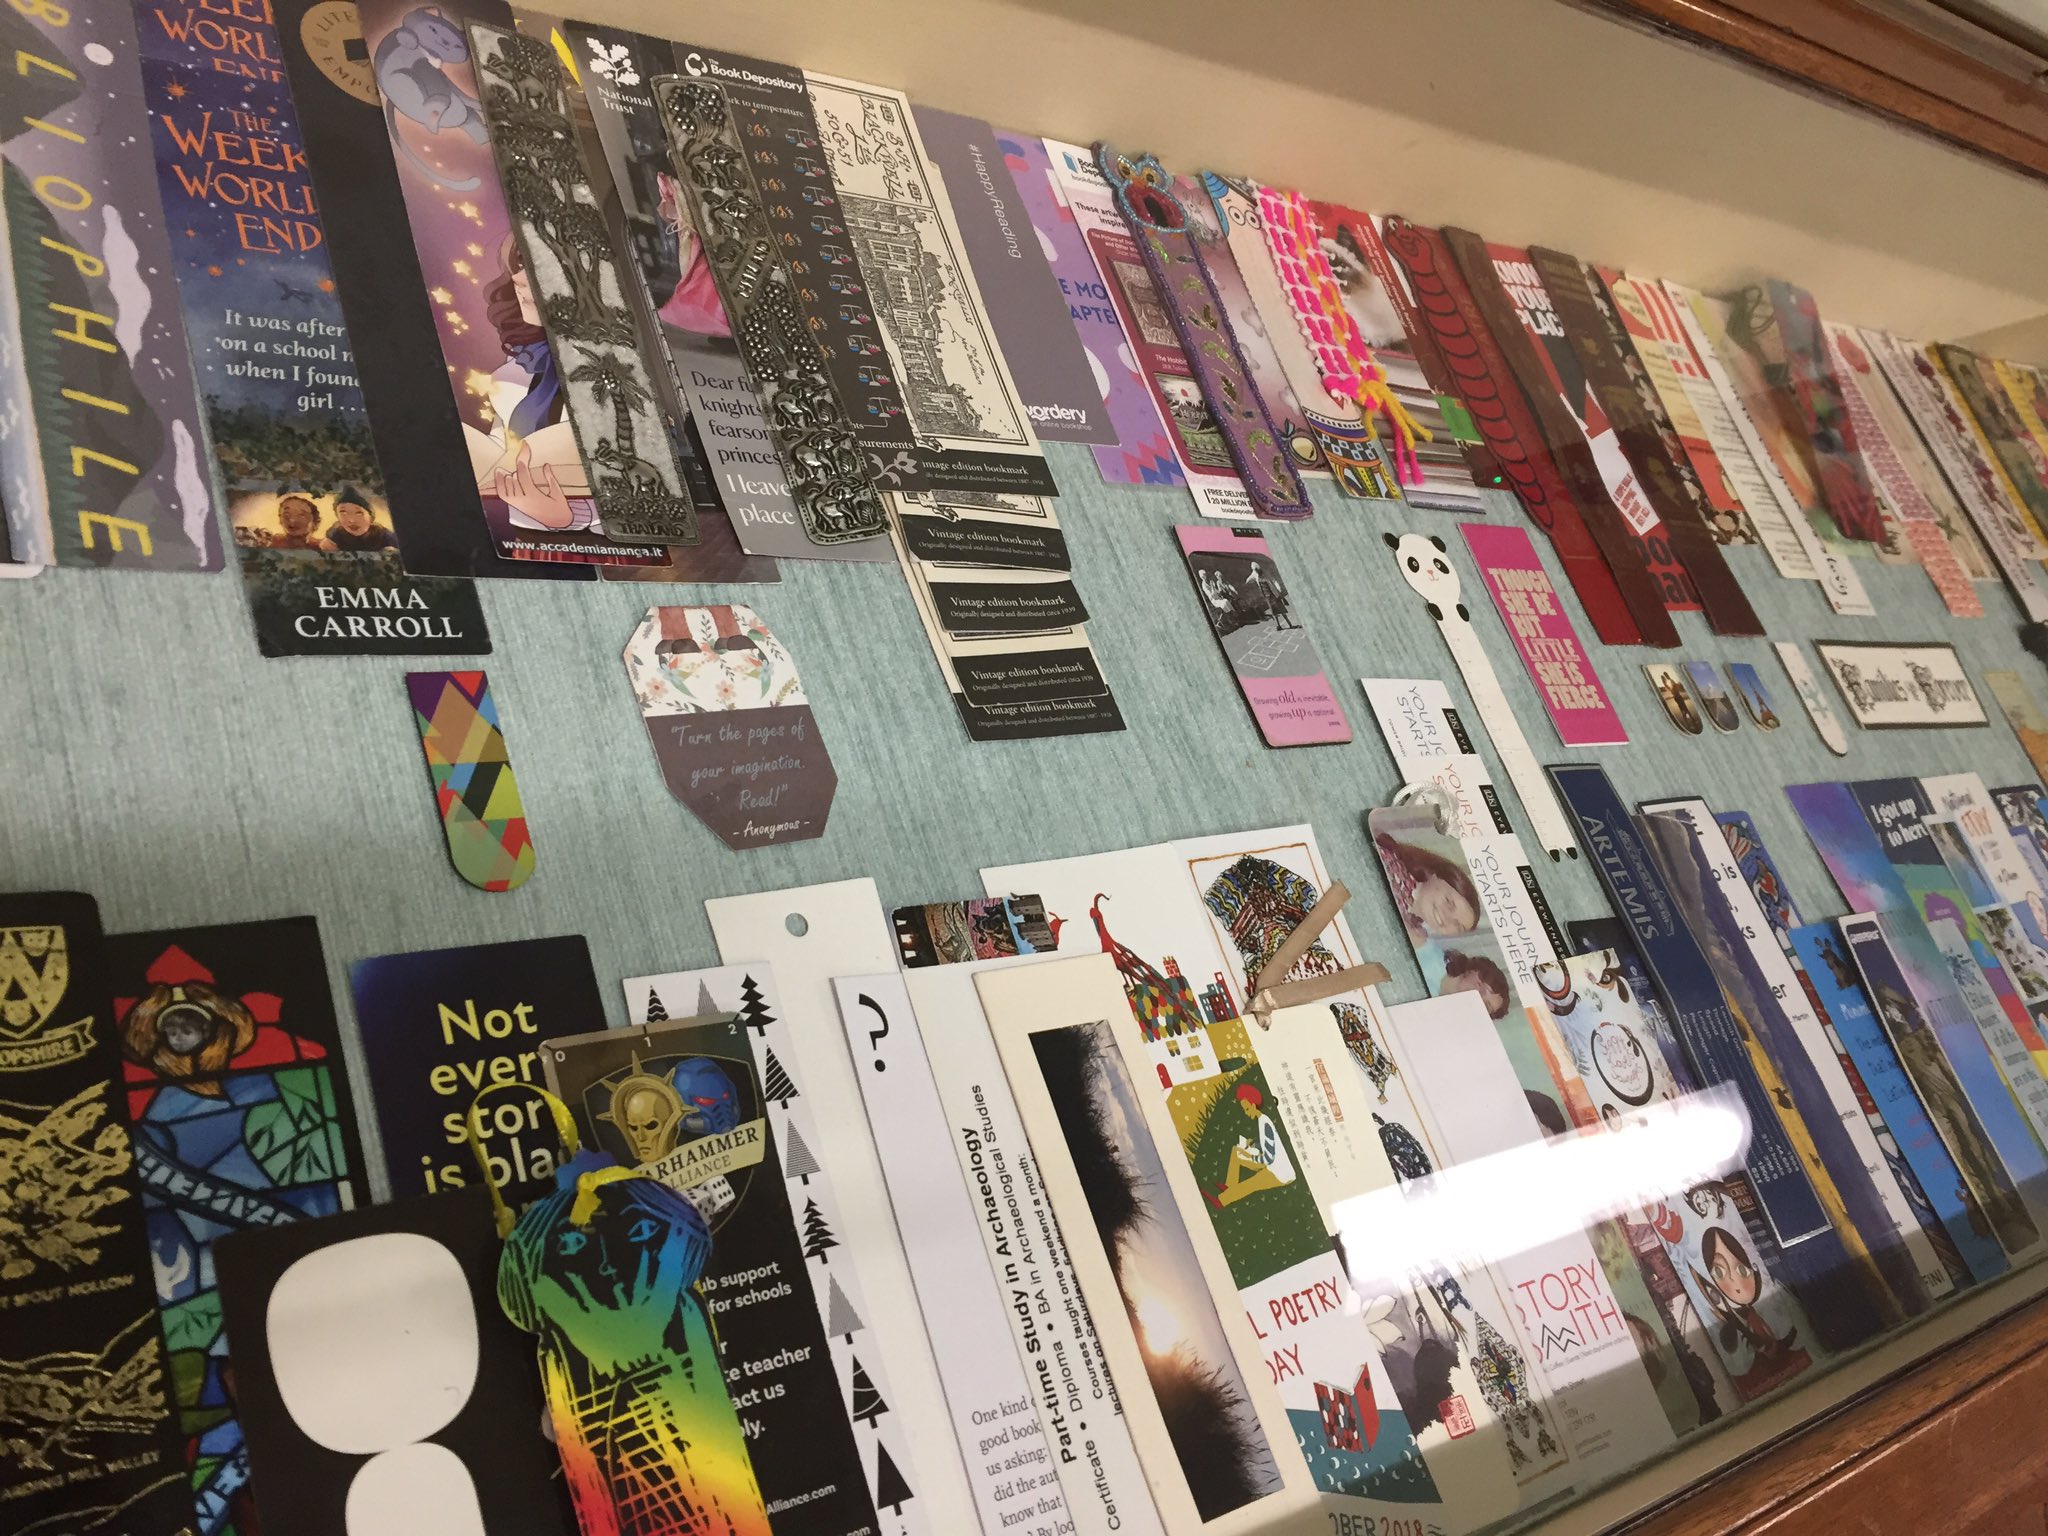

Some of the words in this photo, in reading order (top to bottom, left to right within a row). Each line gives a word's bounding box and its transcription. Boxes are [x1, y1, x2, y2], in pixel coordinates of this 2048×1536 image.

[711, 65, 742, 79] Book
[742, 70, 803, 94] Depository
[597, 86, 653, 108] National
[602, 101, 636, 116] Trust
[742, 99, 751, 107] to
[752, 102, 806, 117] temperature
[227, 108, 274, 132] THE
[161, 112, 308, 172] WEEK
[969, 143, 1021, 259] #HappyReading
[1075, 201, 1099, 214] These
[234, 212, 322, 253] END
[225, 308, 242, 327] It
[248, 316, 291, 332] was
[296, 317, 346, 339] after
[221, 336, 248, 353] on
[253, 341, 267, 355] a
[272, 338, 336, 362] school
[225, 361, 286, 382] when
[292, 365, 301, 382] I
[691, 370, 734, 391] Dear
[297, 394, 333, 412] girl
[952, 462, 982, 472] edition
[984, 463, 1029, 475] bookmark
[726, 474, 735, 493] I
[739, 478, 791, 497] leave
[1207, 488, 1226, 497] FREE
[739, 504, 797, 526] place
[1221, 499, 1248, 507] MILLION
[502, 539, 663, 558] www.accademiamanga.it
[928, 528, 965, 541] Vintage
[967, 532, 999, 542] edition
[1000, 534, 1046, 547] bookmark
[1487, 567, 1553, 594] THOUGH
[315, 585, 430, 612] EMMA
[950, 597, 987, 609] Vintage
[987, 597, 1018, 607] edition
[1020, 596, 1066, 607] bookmark
[1500, 591, 1536, 615] SHE
[1534, 592, 1557, 616] BE
[294, 614, 465, 643] CARROLL
[1510, 614, 1545, 638] BUT
[1524, 638, 1581, 661] LITTLE
[971, 669, 1007, 681] Vintage
[1008, 667, 1039, 678] edition
[1040, 662, 1085, 676] bookmark
[1534, 661, 1569, 685] SHE
[1564, 662, 1586, 685] IS
[983, 704, 1019, 716] Vintage
[1020, 703, 1051, 713] edition
[1049, 699, 1097, 711] bookmark
[1279, 690, 1297, 704] old
[1545, 684, 1606, 710] FIERCE
[1291, 708, 1306, 720] up
[1409, 686, 1436, 736] YOUR
[719, 723, 742, 740] the
[748, 725, 784, 747] pages
[791, 716, 805, 742] of
[691, 767, 724, 789] your
[1445, 763, 1472, 815] YOUR
[1879, 803, 1901, 828] got
[1899, 798, 1917, 819] up
[743, 820, 800, 839] Anonymous
[1888, 827, 1903, 847] to
[1481, 844, 1511, 899] YOUR
[1582, 815, 1660, 940] ARTEMIS
[1722, 864, 1737, 880] is
[1470, 857, 1508, 929] STARTS
[1502, 934, 1533, 985] HERE
[437, 999, 538, 1046] Not
[644, 1036, 652, 1048] 1
[728, 1023, 738, 1036] 2
[971, 1084, 997, 1143] Studies
[637, 1124, 759, 1187] ARHAMMER
[421, 1153, 466, 1193] is
[662, 1153, 732, 1189] LLIANCE
[961, 1127, 1012, 1257] Archaeology
[1033, 1198, 1041, 1208] a
[989, 1147, 1036, 1266] Archaeological
[1034, 1209, 1061, 1268] weekend
[720, 1261, 781, 1289] support
[1004, 1264, 1020, 1284] in
[1029, 1270, 1042, 1286] in
[1055, 1270, 1070, 1295] one
[709, 1297, 732, 1315] for
[735, 1281, 792, 1309] schools
[1034, 1289, 1051, 1315] BA
[1267, 1275, 1343, 1331] POETRY
[1012, 1289, 1041, 1354] Study
[1064, 1298, 1084, 1339] taught
[743, 1345, 811, 1377] teacher
[1078, 1342, 1104, 1400] Courses
[1052, 1340, 1083, 1412] Diploma
[764, 1382, 786, 1401] us
[971, 1408, 998, 1427] One
[999, 1395, 1029, 1412] kind
[1035, 1358, 1078, 1464] Part-time
[978, 1432, 1010, 1456] good
[1012, 1418, 1042, 1440] book
[986, 1462, 1002, 1477] us
[1003, 1447, 1048, 1475] asking:
[993, 1484, 1015, 1502] did
[1016, 1477, 1037, 1494] the
[1084, 1439, 1121, 1531] Certificate
[999, 1506, 1035, 1528] know
[1037, 1496, 1062, 1514] that
